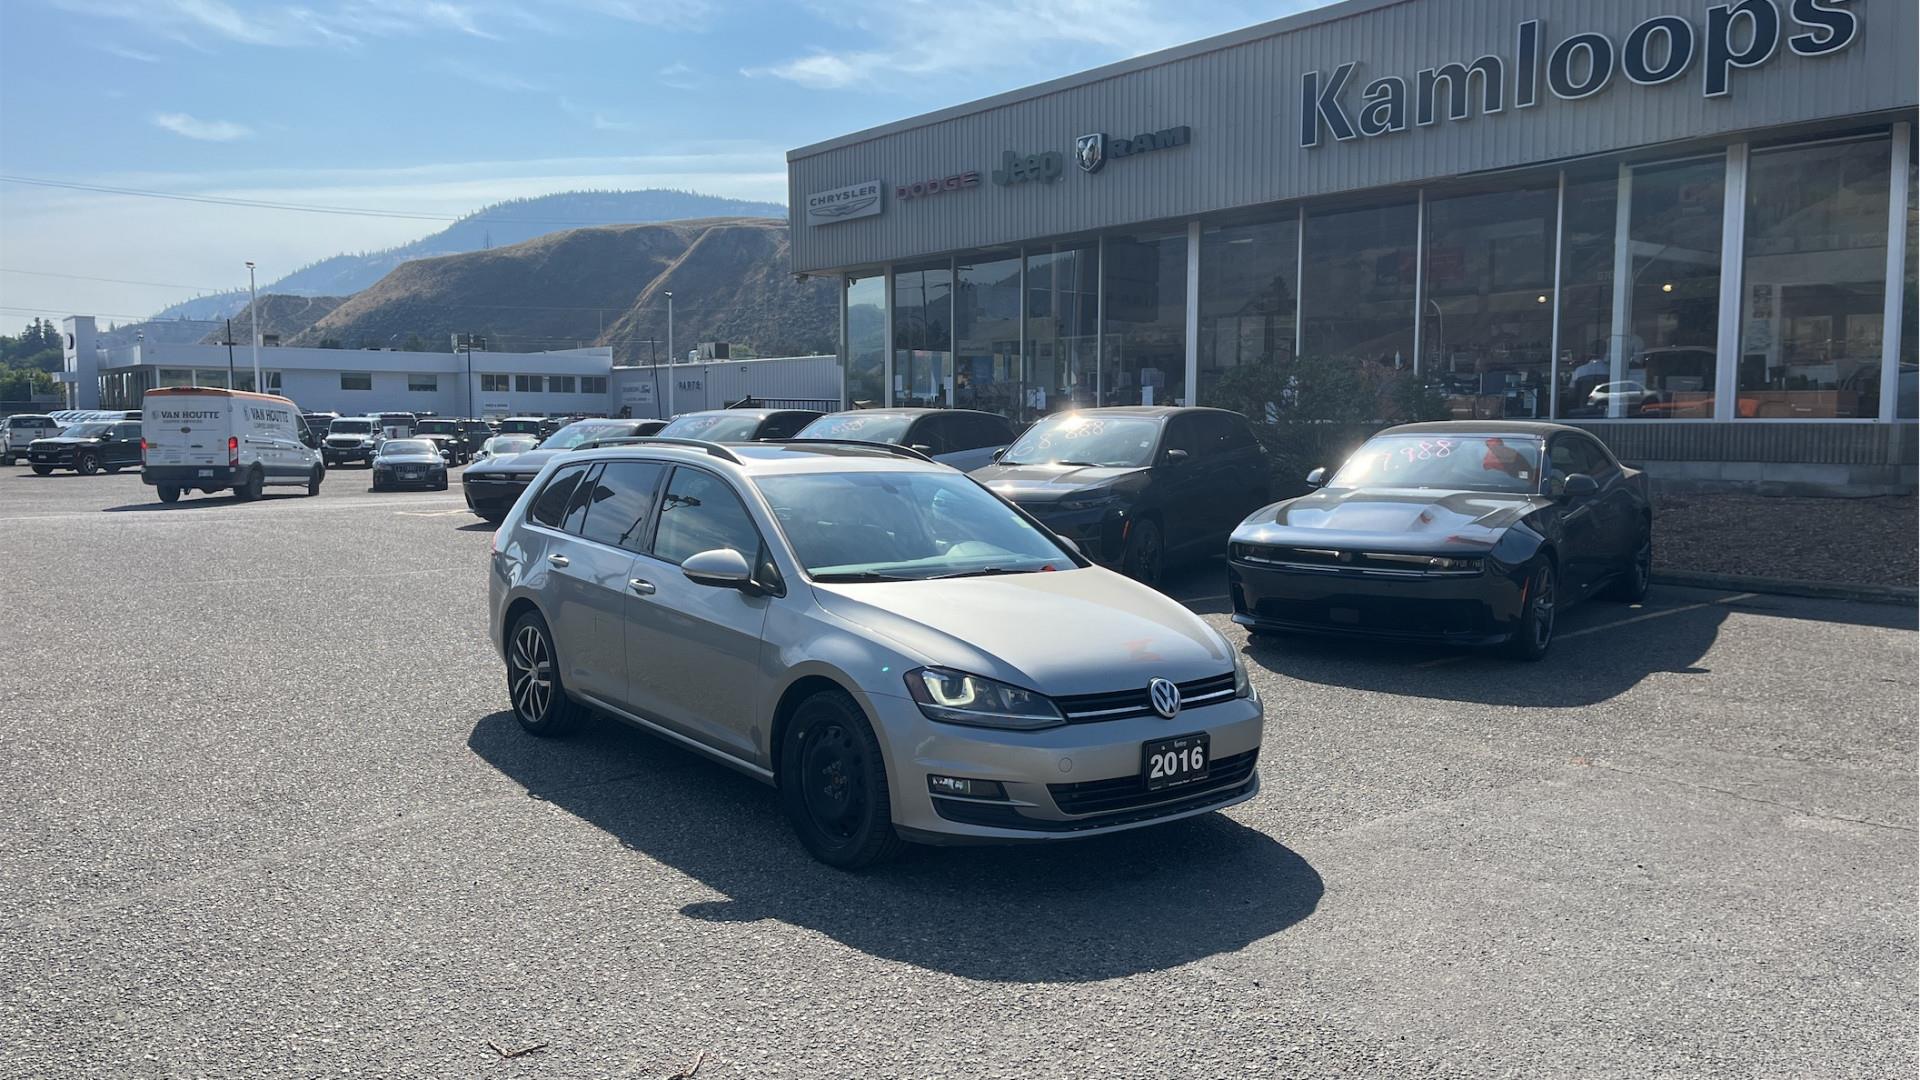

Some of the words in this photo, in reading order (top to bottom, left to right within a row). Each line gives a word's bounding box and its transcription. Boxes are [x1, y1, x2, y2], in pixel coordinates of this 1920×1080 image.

[1299, 0, 1861, 149] Kamloops
[1108, 126, 1191, 159] RAM
[991, 150, 1062, 187] Jeep
[809, 184, 878, 207] CHRYSLER
[895, 170, 982, 201] DODGE
[161, 410, 180, 419] VAN
[182, 411, 220, 419] HOUTTE
[250, 407, 265, 421] VAN
[266, 409, 289, 423] HOUTTE
[1150, 746, 1204, 779] 2016
